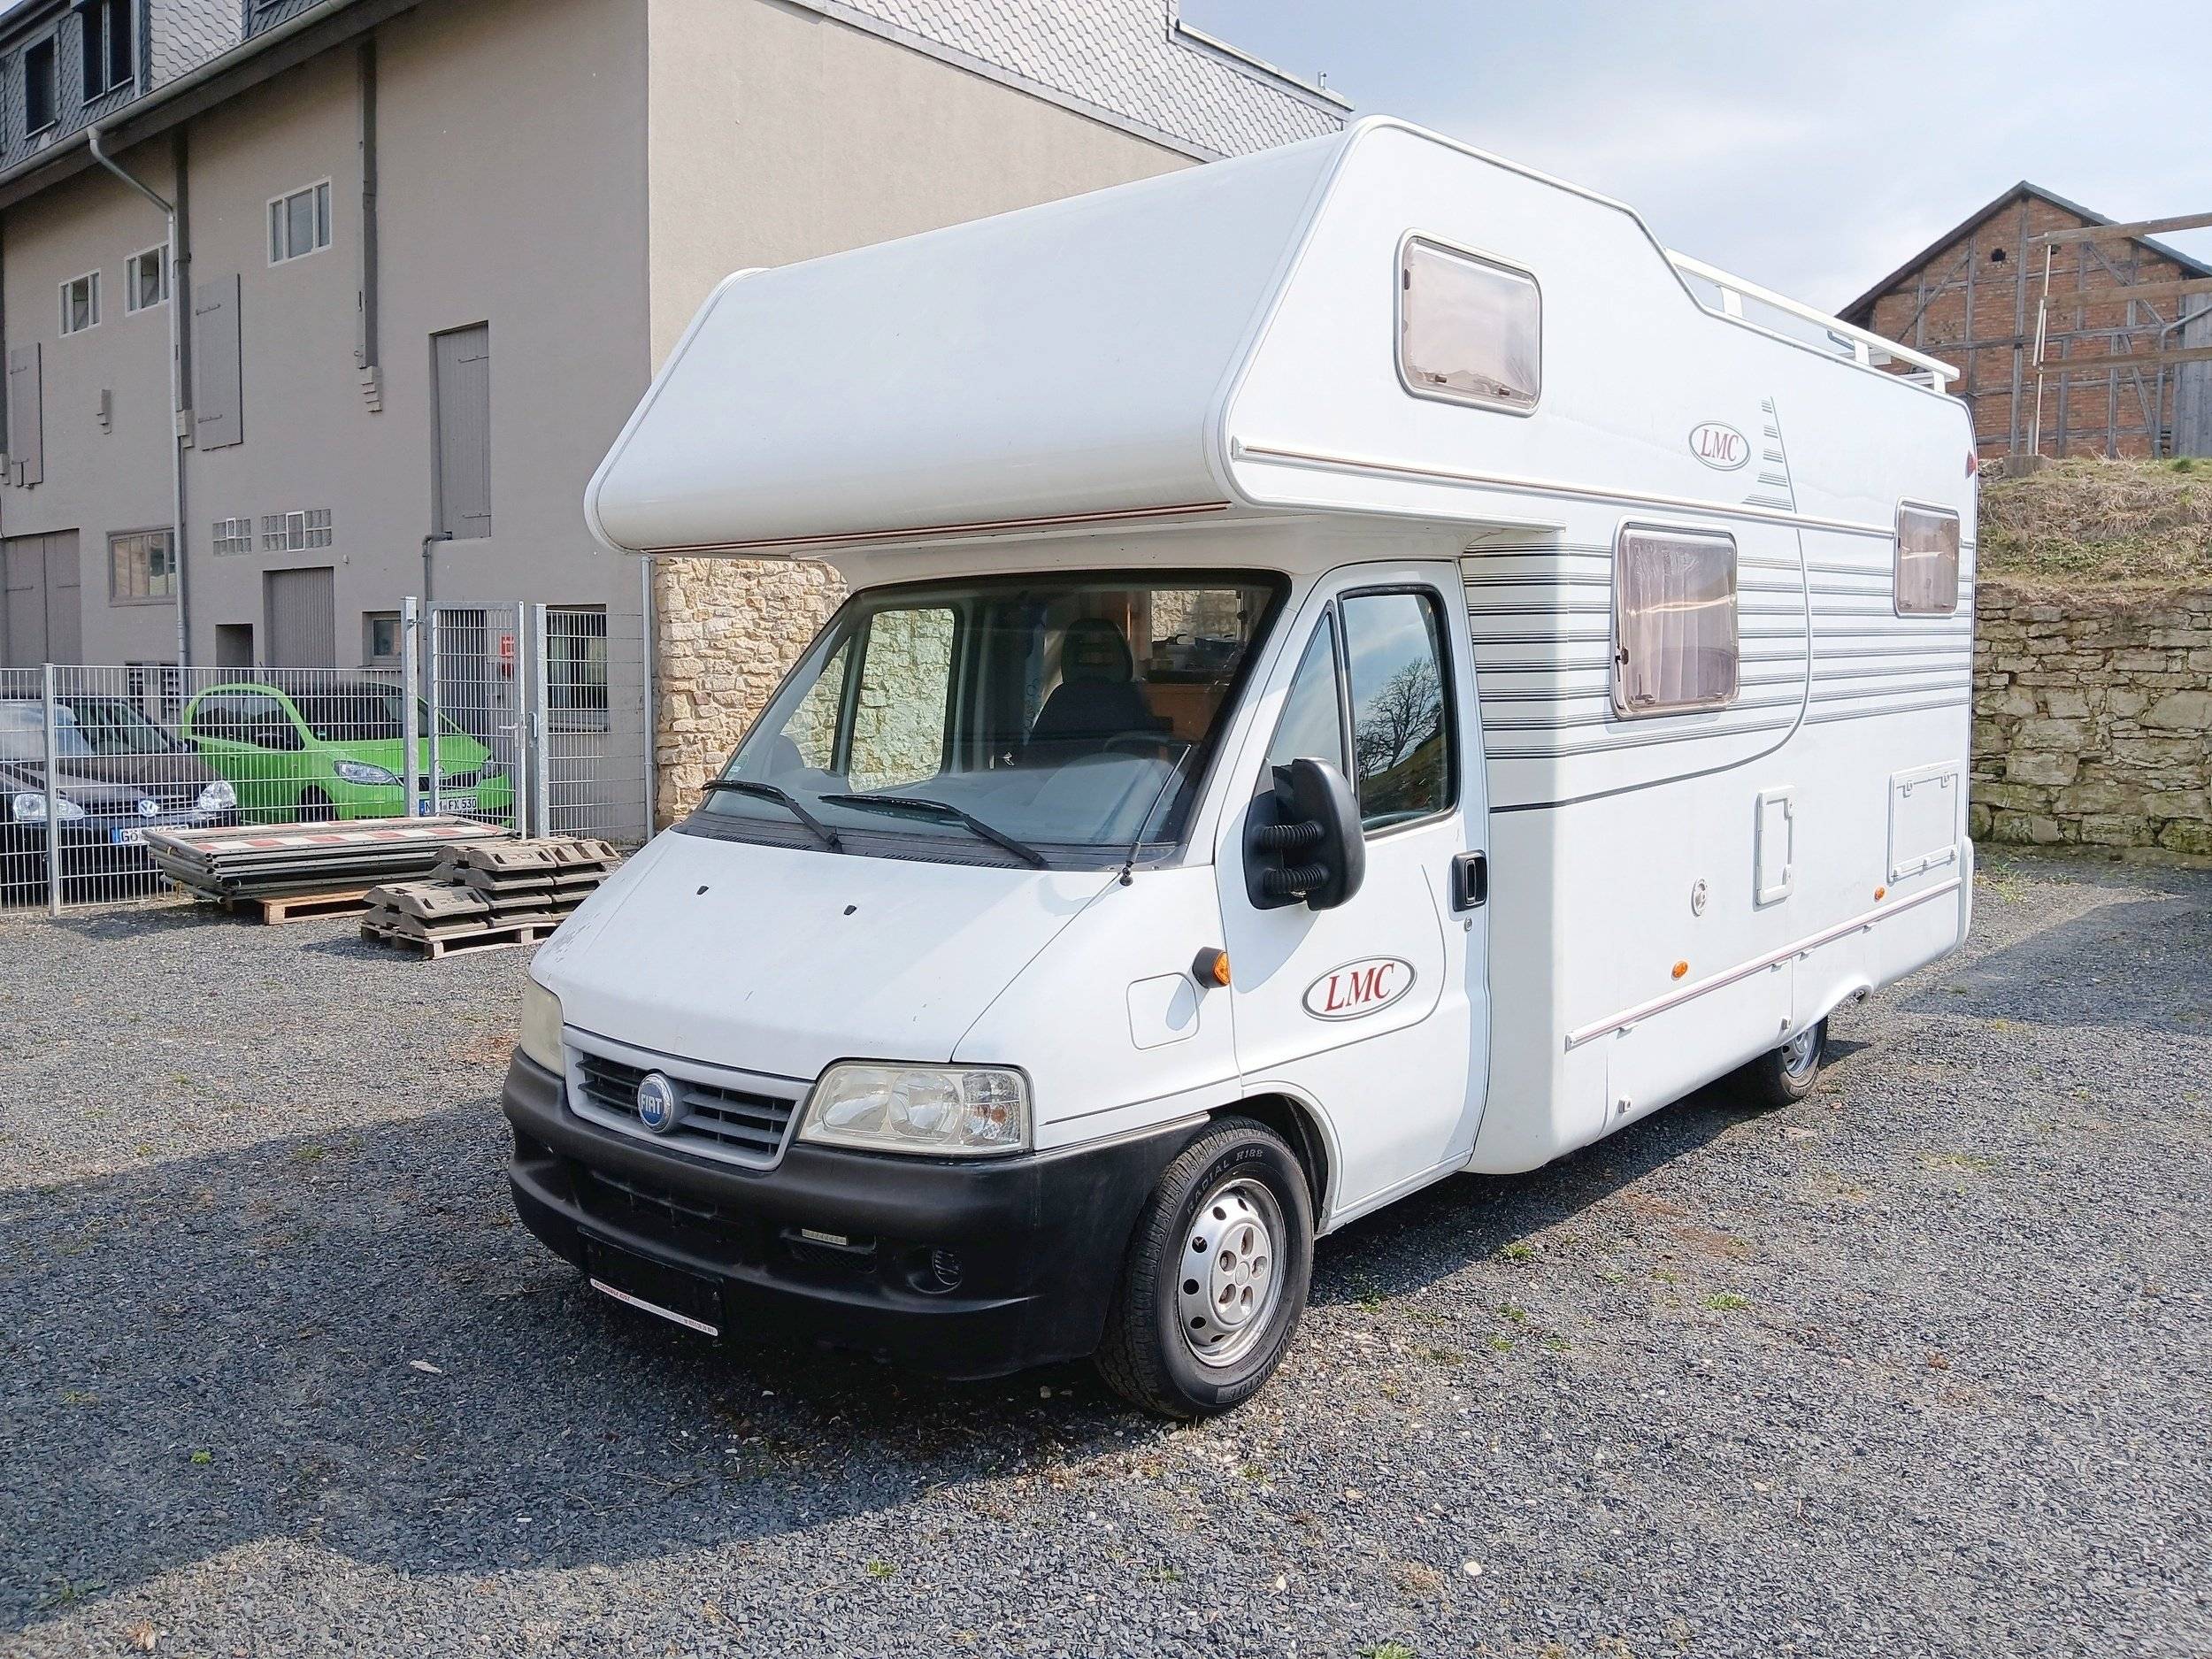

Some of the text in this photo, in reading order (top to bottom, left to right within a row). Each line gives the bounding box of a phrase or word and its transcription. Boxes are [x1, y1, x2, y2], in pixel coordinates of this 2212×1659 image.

[1700, 428, 1739, 462] LMC
[121, 830, 138, 842] GÖ
[1325, 962, 1395, 1012] LMC
[641, 1094, 663, 1115] FIAT
[1187, 1159, 1230, 1215] RADIAL
